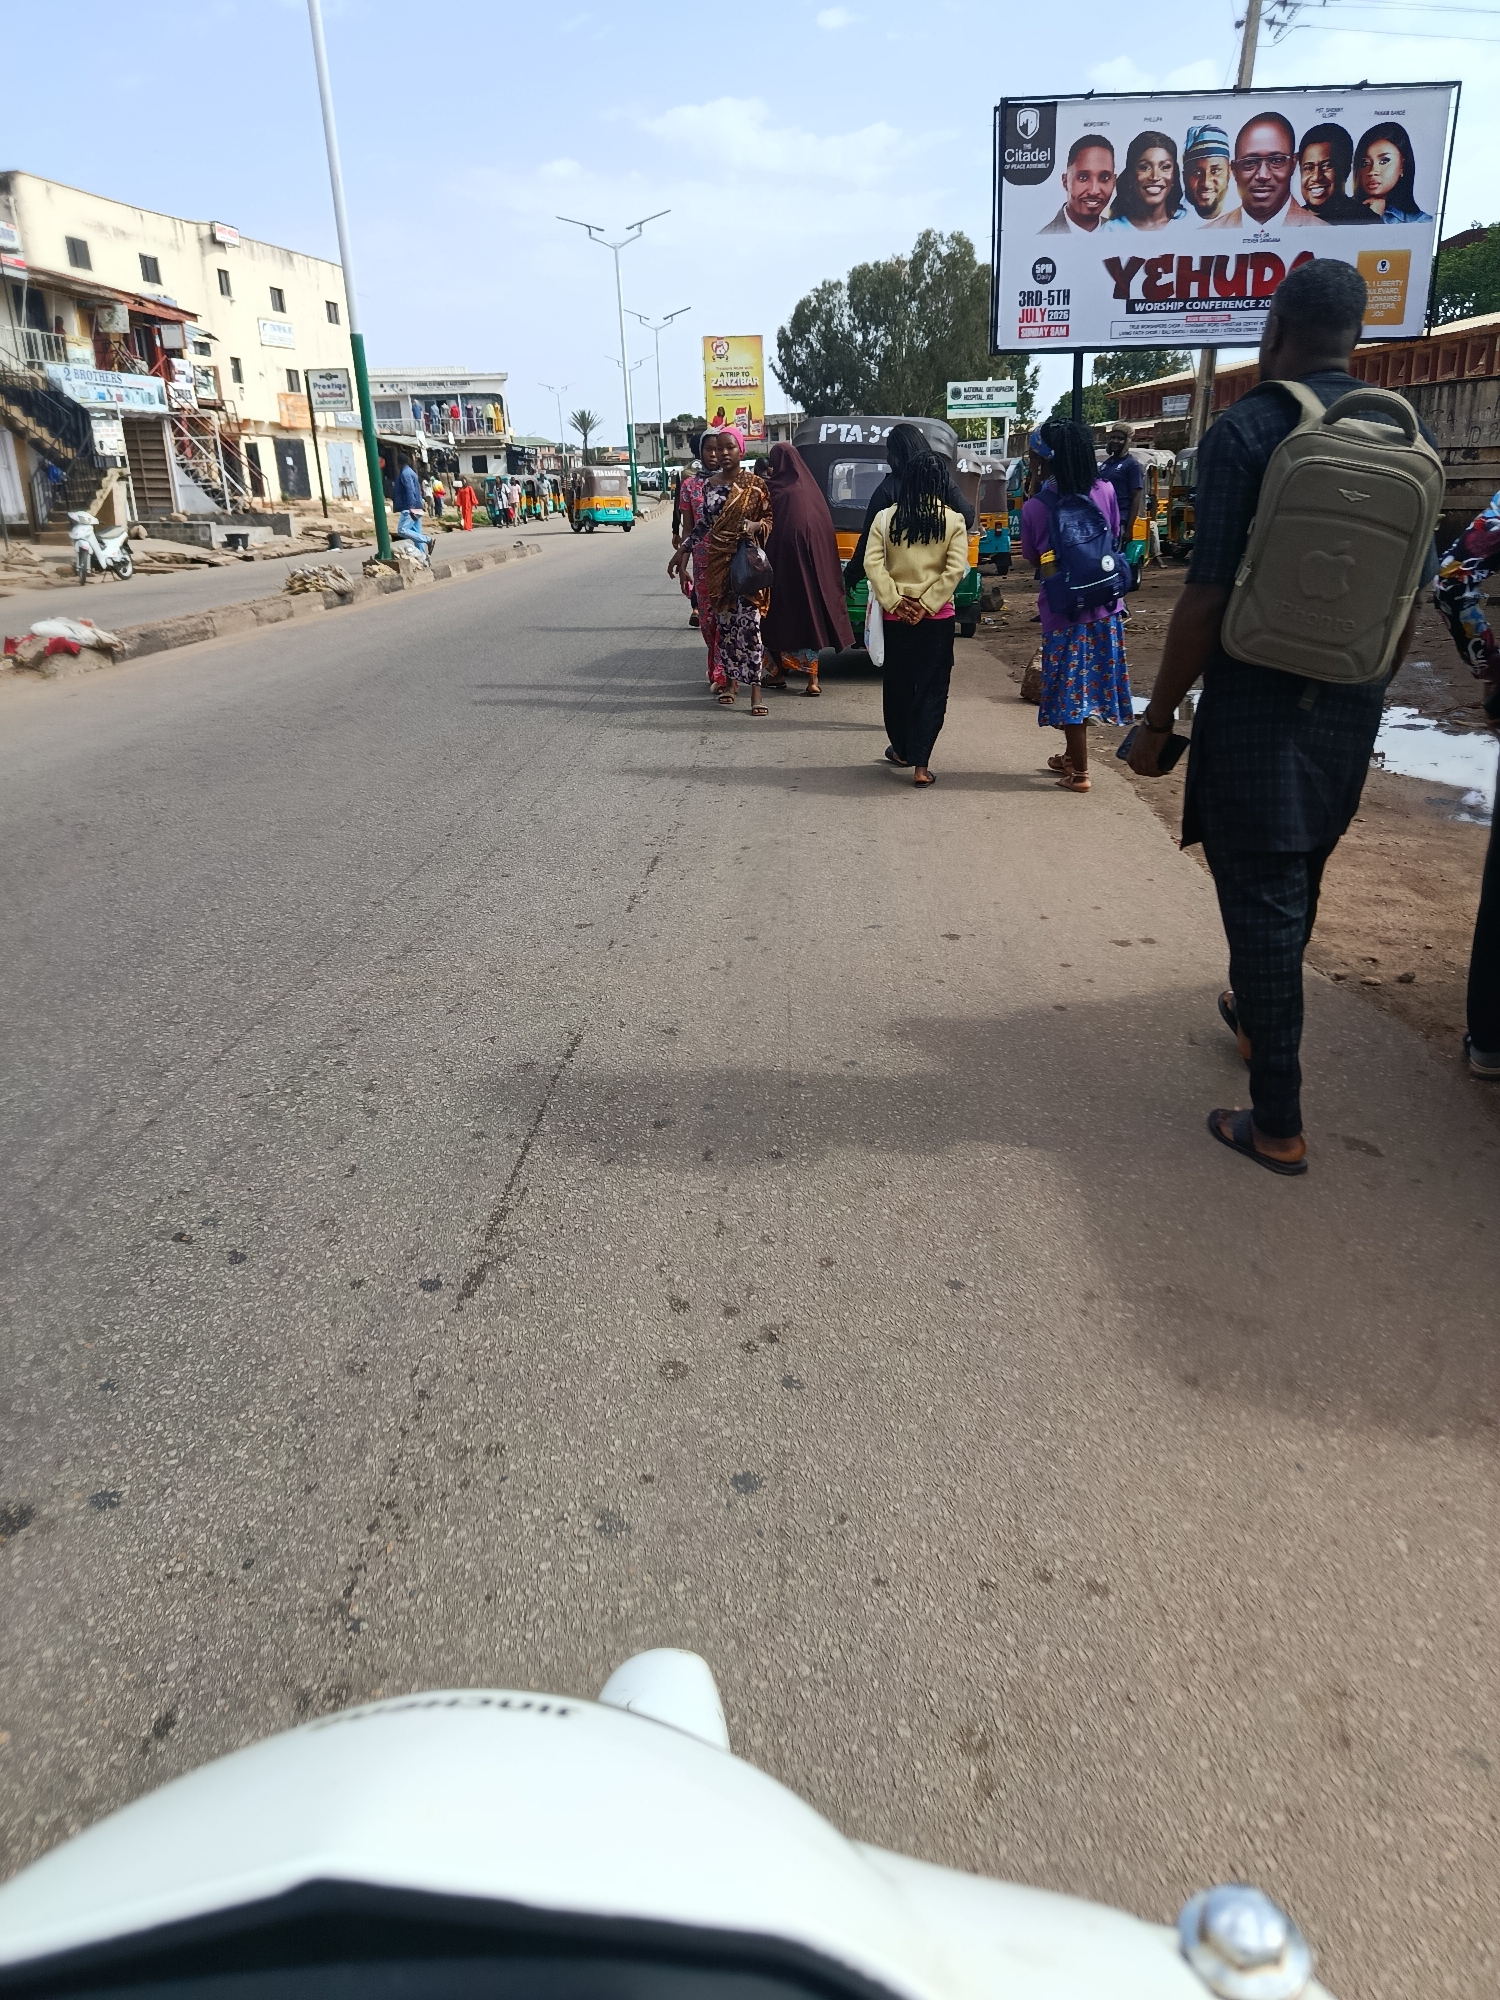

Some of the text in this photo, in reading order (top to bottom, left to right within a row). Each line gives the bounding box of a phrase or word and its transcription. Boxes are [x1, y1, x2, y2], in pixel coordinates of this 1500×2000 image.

[1004, 147, 1051, 163] Citadel
[1035, 263, 1053, 274] 5PM
[1036, 273, 1052, 281] Daily
[1376, 279, 1404, 287] LIBERTY
[1018, 288, 1071, 307] 3RD-5TH
[1134, 302, 1184, 312] WORSHIP
[1186, 299, 1256, 310] CONFERENCE
[1018, 307, 1069, 324] JULY 2026
[1020, 326, 1050, 338] SUNDAY
[63, 366, 73, 382] 2
[73, 368, 123, 385] BROTHERS
[711, 377, 760, 388] ZANZIBAR
[985, 393, 994, 401] JOS
[524, 447, 536, 455] POS
